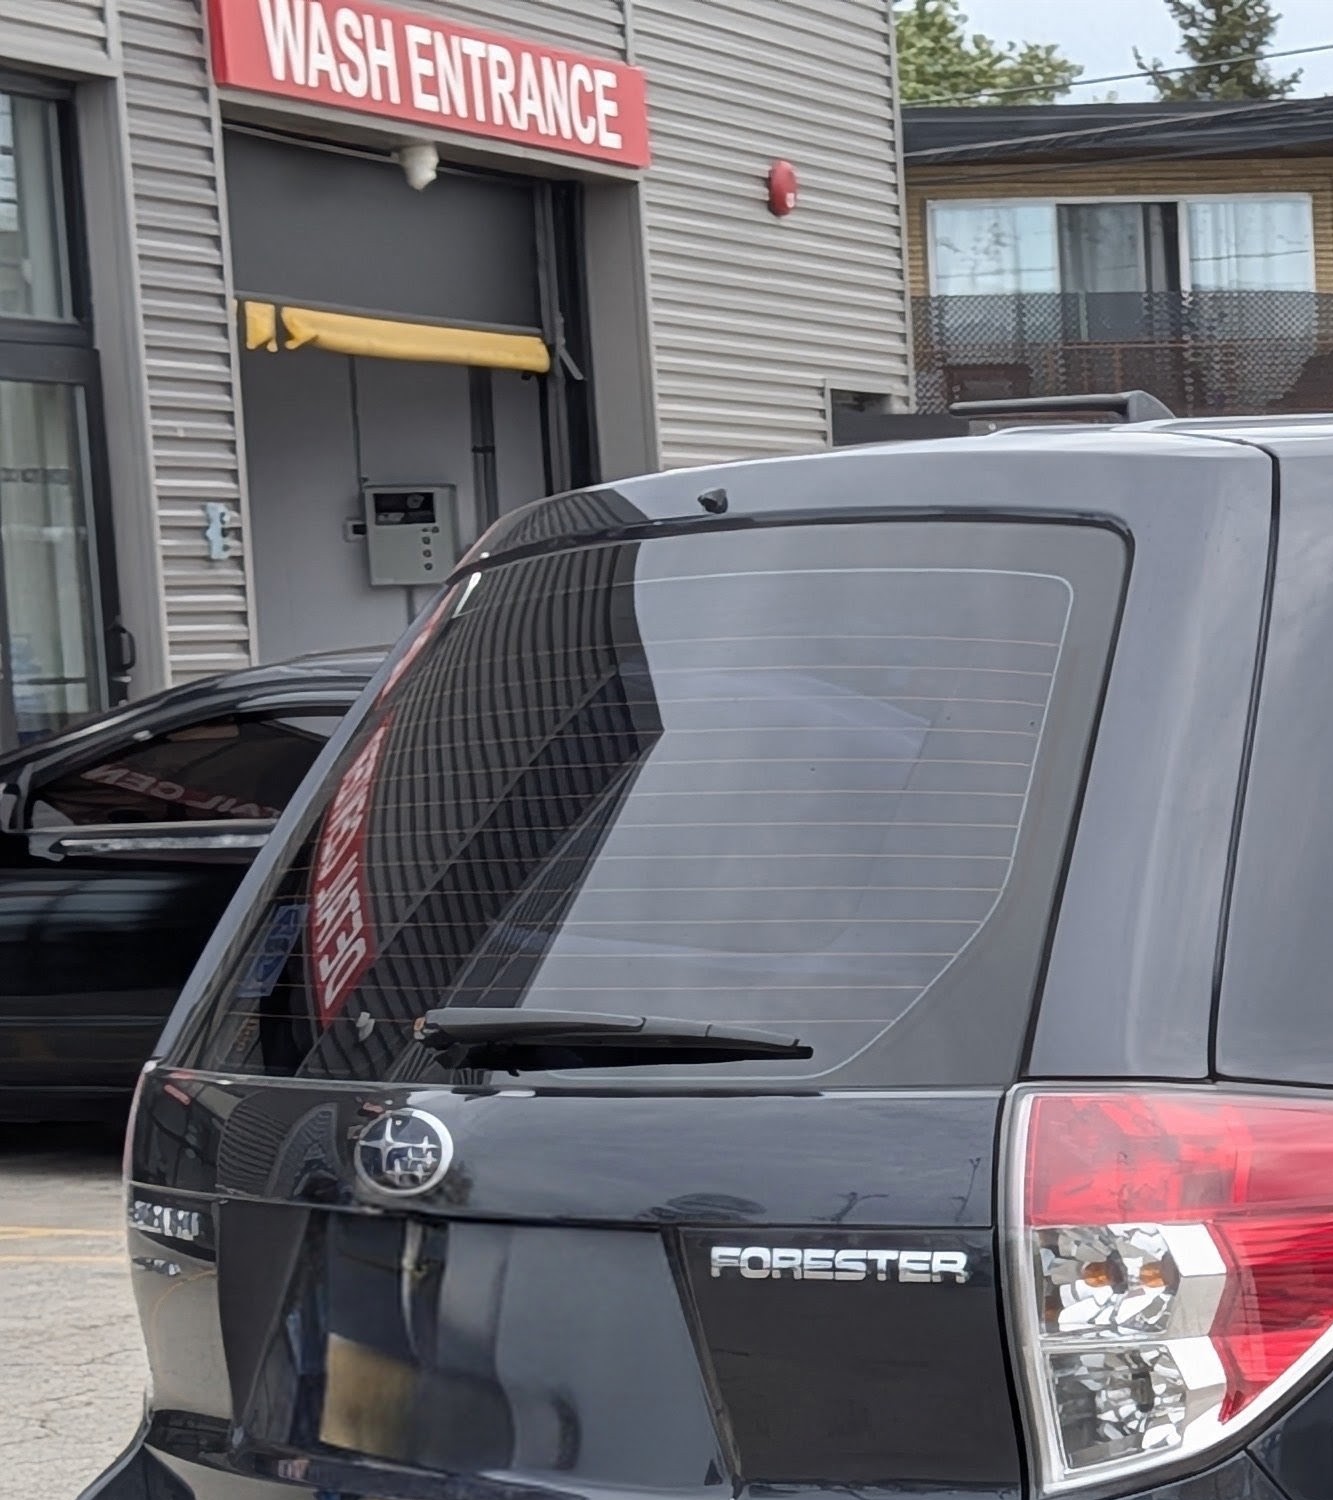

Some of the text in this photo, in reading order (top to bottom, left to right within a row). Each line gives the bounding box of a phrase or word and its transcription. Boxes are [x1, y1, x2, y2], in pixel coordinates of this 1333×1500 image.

[258, 0, 623, 150] WASH ENTRANCE
[710, 1246, 969, 1284] FORESTER
